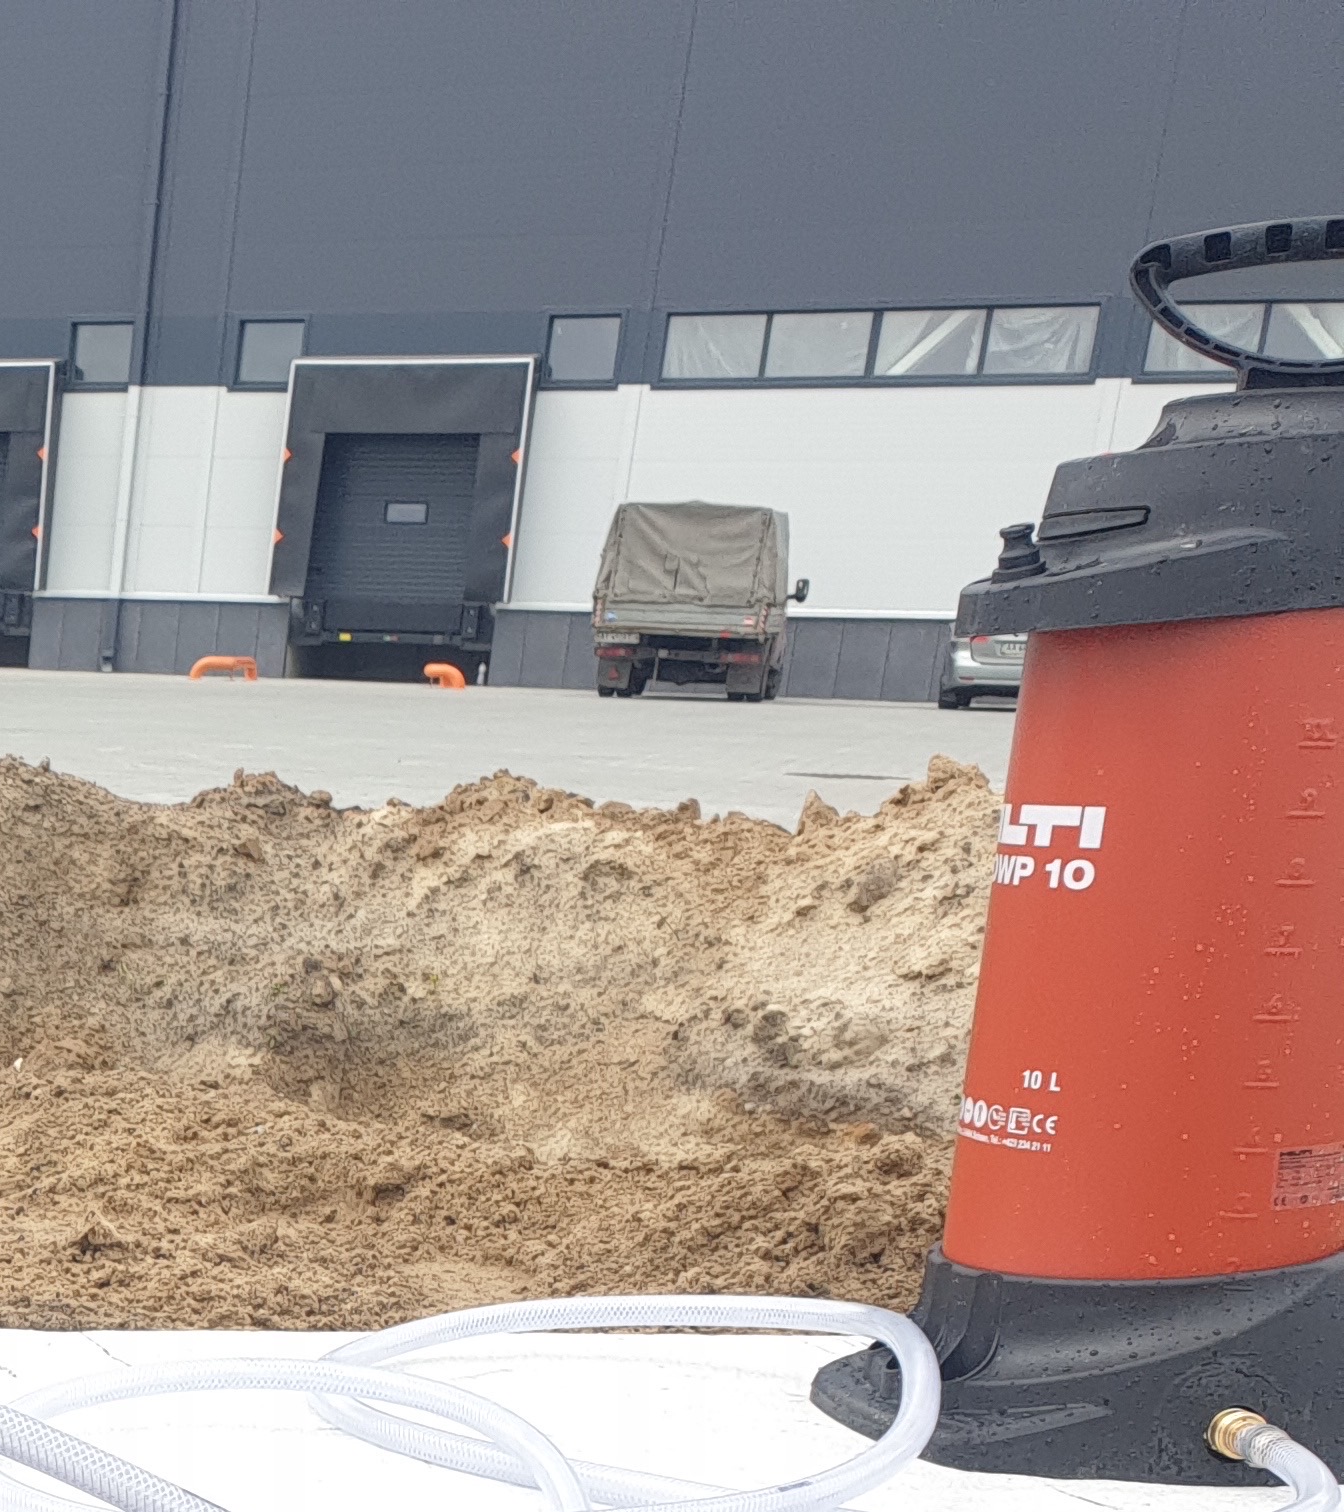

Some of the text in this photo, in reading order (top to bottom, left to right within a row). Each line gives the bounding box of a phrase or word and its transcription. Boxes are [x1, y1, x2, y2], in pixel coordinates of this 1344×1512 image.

[997, 803, 1107, 849] LTI
[1045, 858, 1096, 891] 10
[1022, 1069, 1061, 1092] 10 L
